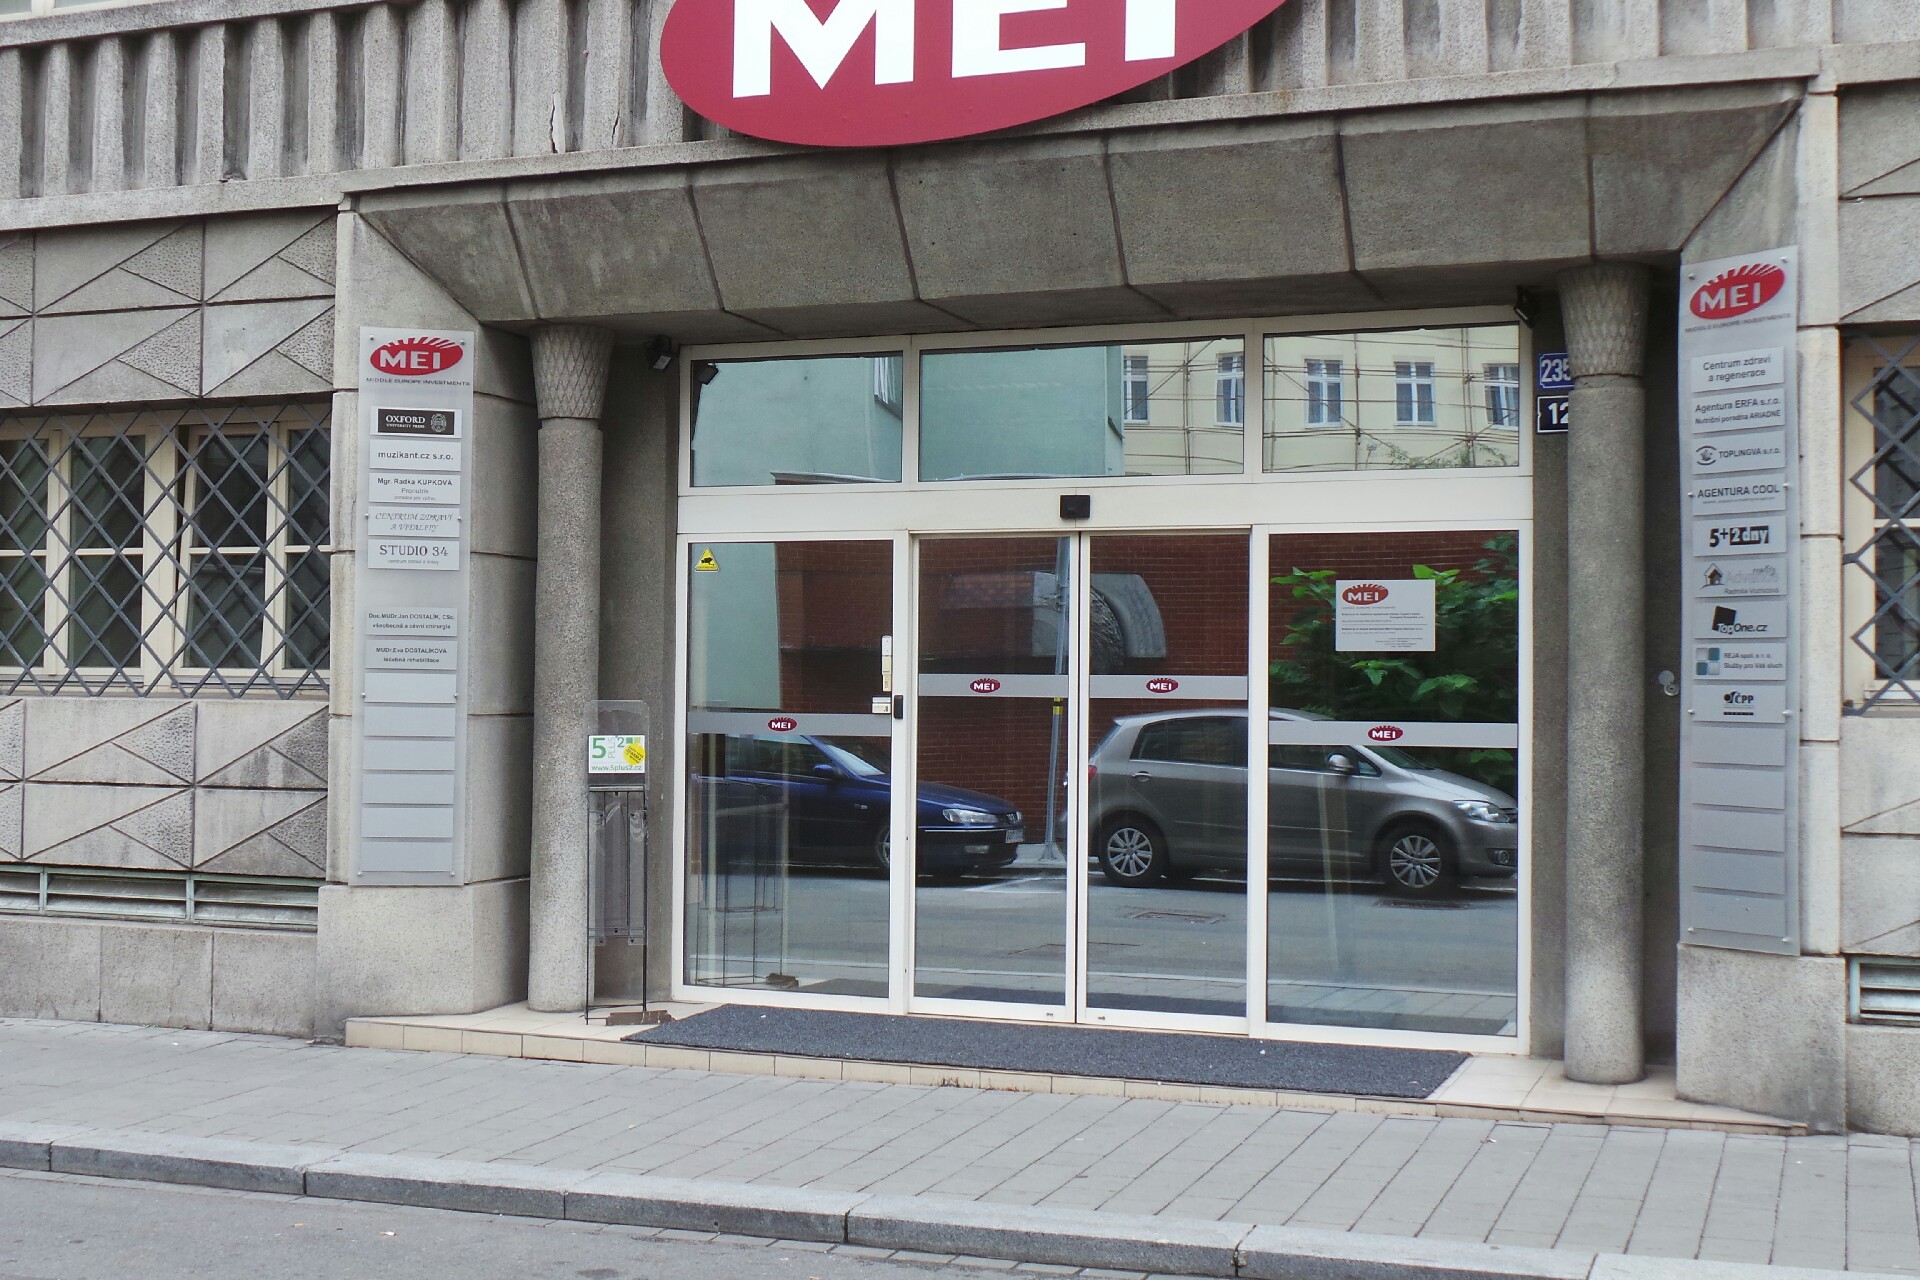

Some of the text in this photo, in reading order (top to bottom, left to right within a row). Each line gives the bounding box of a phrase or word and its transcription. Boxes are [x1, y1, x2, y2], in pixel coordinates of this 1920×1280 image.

[1699, 282, 1761, 313] MEI
[379, 349, 441, 370] MEI
[1702, 360, 1741, 371] Centrum
[1708, 368, 1766, 382] a regenerace
[1695, 397, 1781, 414] Agentura ERFA s.r.o.
[385, 414, 426, 424] OXFORD
[1548, 402, 1569, 425] 12
[1749, 409, 1781, 419] ARIADNE
[377, 451, 454, 461] muzikant.cz s.r.o.
[1718, 447, 1781, 459] TOPLINGVA s.r.o.
[393, 478, 416, 486] Radka
[1697, 484, 1781, 499] AGENTURA COOL
[375, 512, 419, 522] CENTRUM
[379, 544, 449, 557] STUDIO 34
[1347, 592, 1380, 602] MEI
[1718, 623, 1768, 635] TopOne.cz
[973, 682, 995, 691] MEI
[1149, 682, 1172, 691] MEI
[1734, 692, 1754, 704] ČPP
[771, 721, 791, 729] MEI
[1371, 730, 1397, 739] MEI
[592, 737, 606, 758] 5
[617, 737, 625, 747] 2
